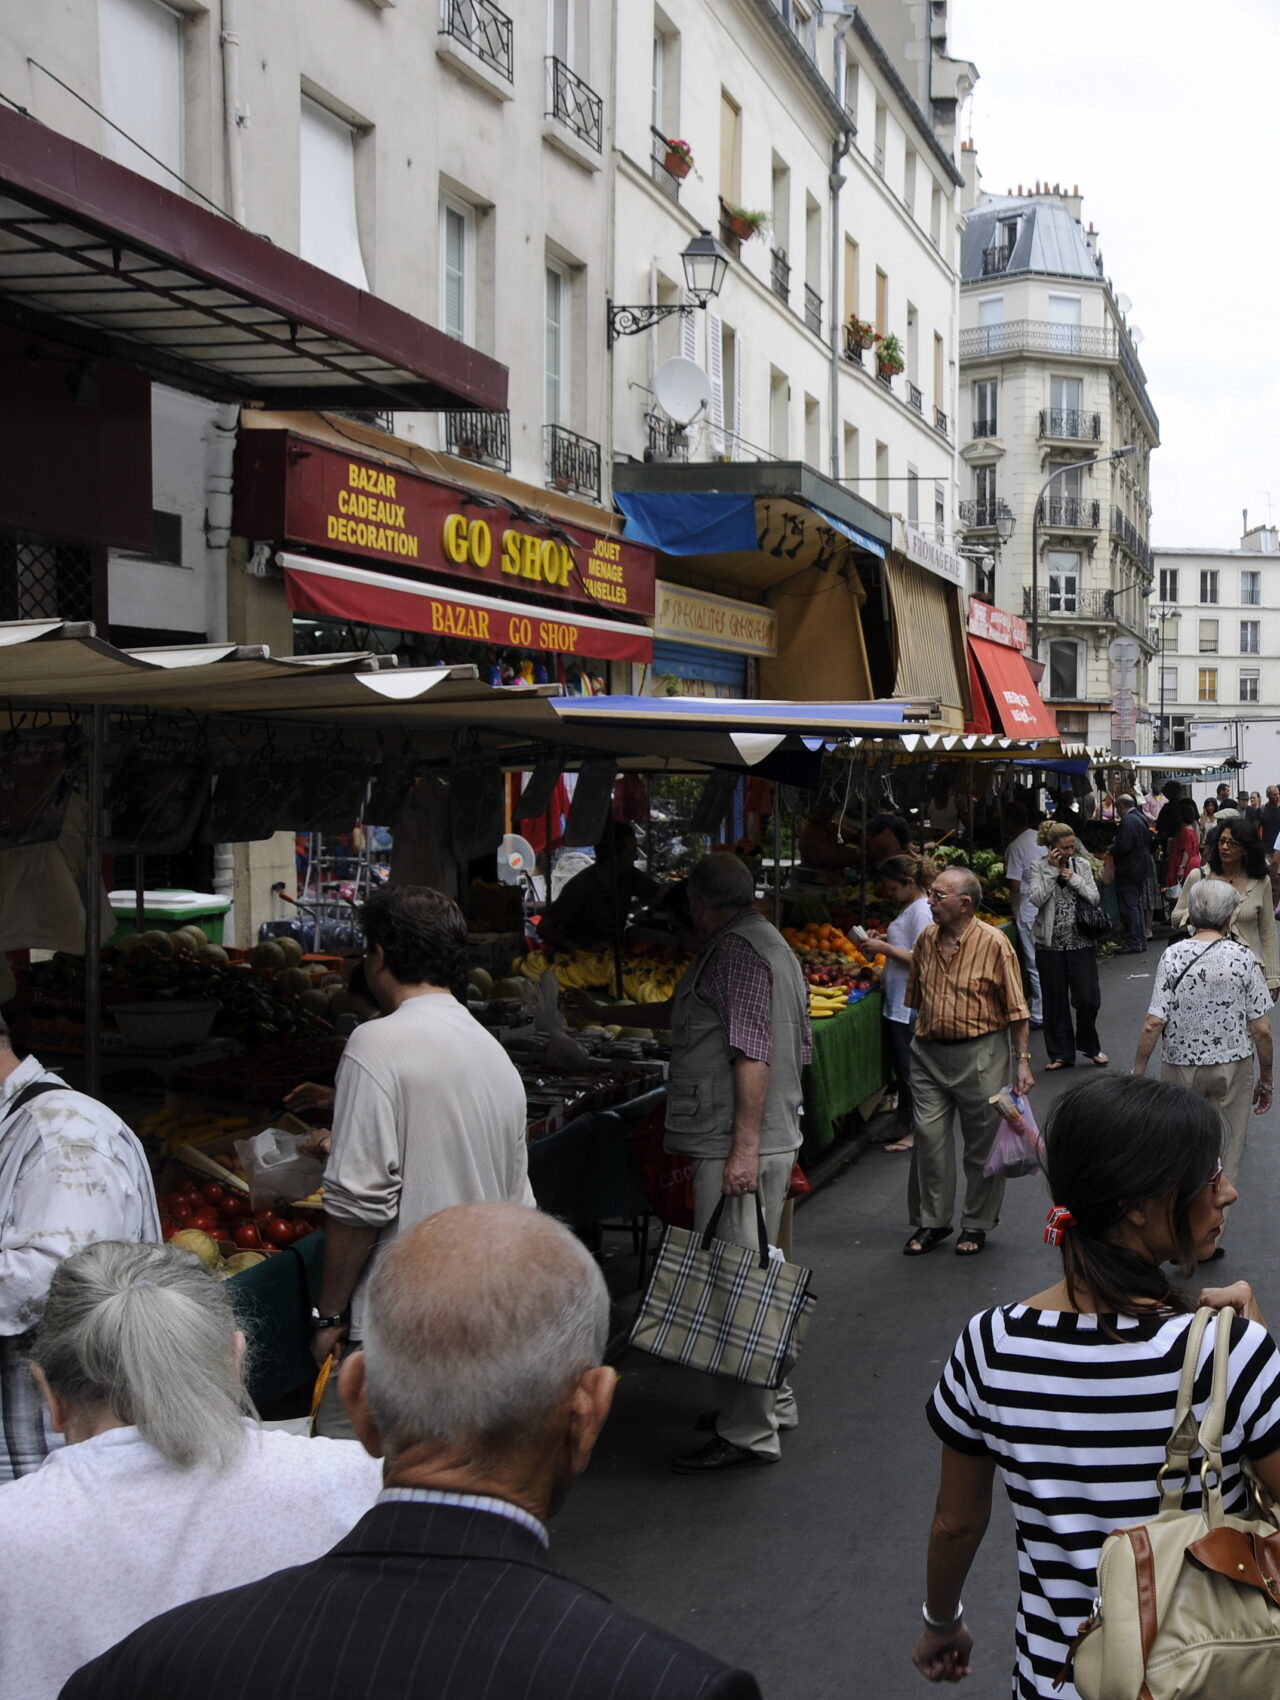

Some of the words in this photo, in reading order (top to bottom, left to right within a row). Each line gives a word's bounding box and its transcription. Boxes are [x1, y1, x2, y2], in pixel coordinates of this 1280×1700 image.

[349, 463, 396, 499] BAZAR
[338, 490, 406, 529] CADEAUX
[327, 514, 418, 558] DECORATION
[443, 513, 491, 568] GO
[501, 529, 575, 587] SHOP
[592, 538, 621, 560] JOUET
[913, 534, 960, 578] FROMAGERIE
[588, 558, 623, 584] MENAGE
[430, 601, 490, 640] BAZAR
[509, 616, 533, 647] GO
[539, 622, 579, 653] SHOP
